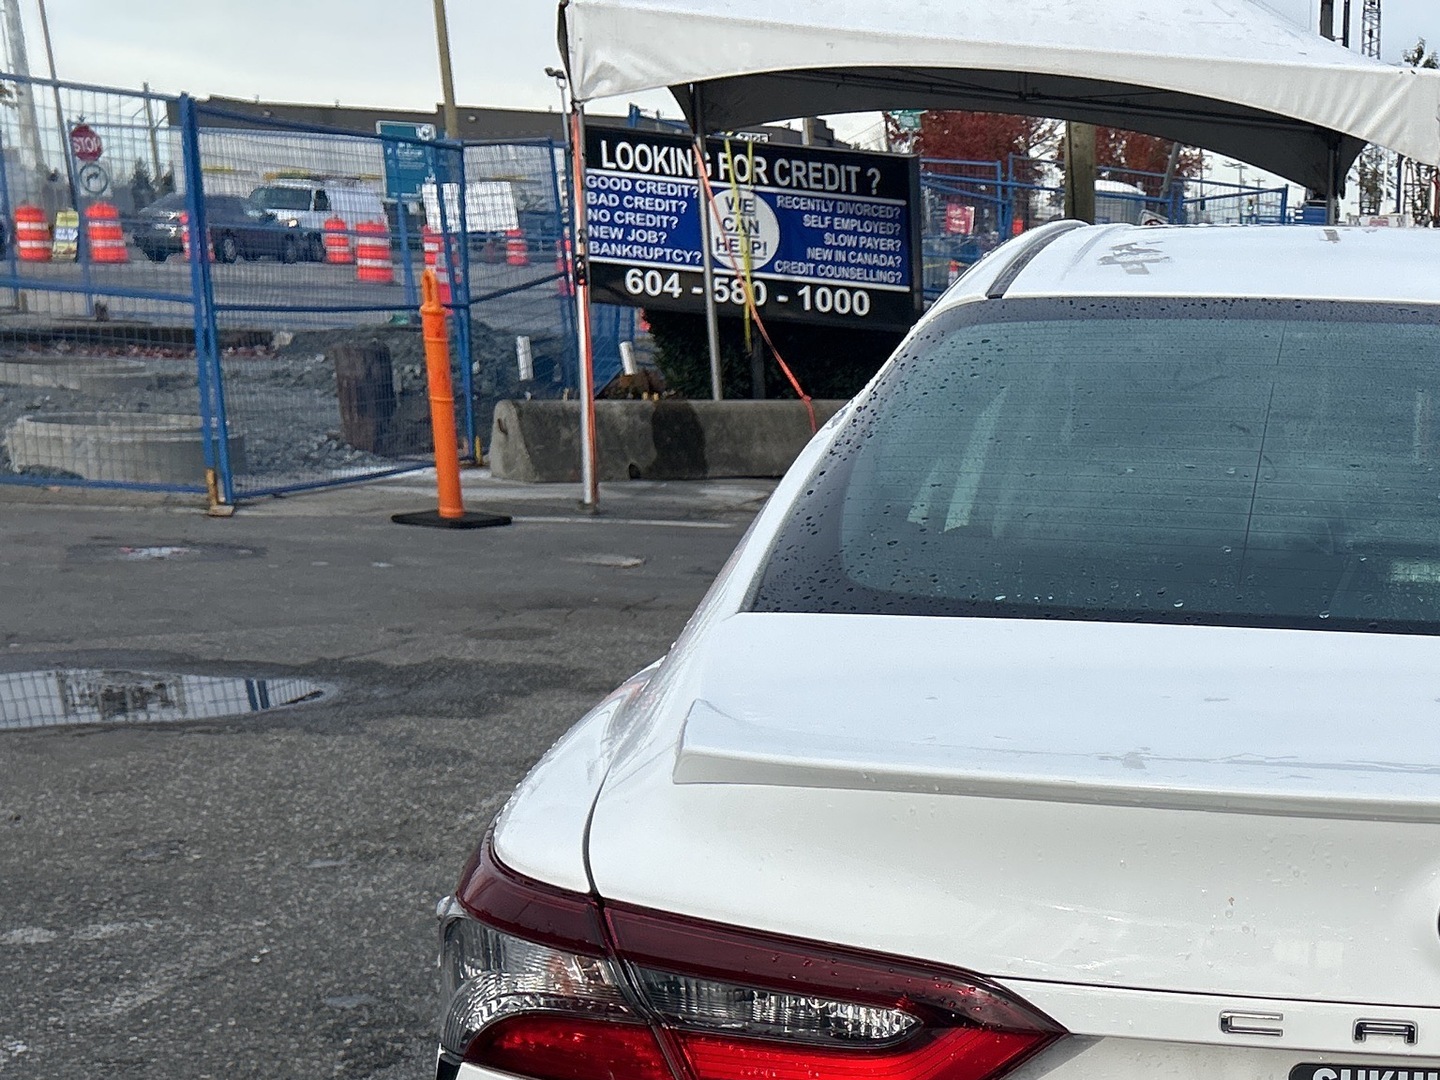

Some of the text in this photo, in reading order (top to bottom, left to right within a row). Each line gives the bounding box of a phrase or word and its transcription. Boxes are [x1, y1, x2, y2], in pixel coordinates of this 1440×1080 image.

[73, 136, 99, 153] STOP
[718, 152, 769, 185] FOR
[774, 158, 861, 193] CREDIT
[586, 175, 699, 199] GOOD CREDIT?
[586, 191, 688, 214] BAD CREDIT?
[725, 196, 755, 213] WE
[777, 196, 900, 219] RECENTLY DIVORCED?
[587, 208, 679, 230] NO CREDIT?
[722, 217, 760, 234] CAN
[803, 213, 901, 236] SELF EMPLOYED?
[588, 225, 668, 245] NEW JOB?
[716, 236, 767, 256] HEP!
[824, 232, 902, 252] SLOW PAYER?
[589, 241, 702, 265] BANKRUPTCY?
[807, 247, 902, 268] NEW IN CANADA?
[774, 259, 902, 284] CREDIT COUNSELLING?
[625, 268, 683, 298] 604
[713, 277, 767, 307] 580
[797, 284, 871, 316] 1000
